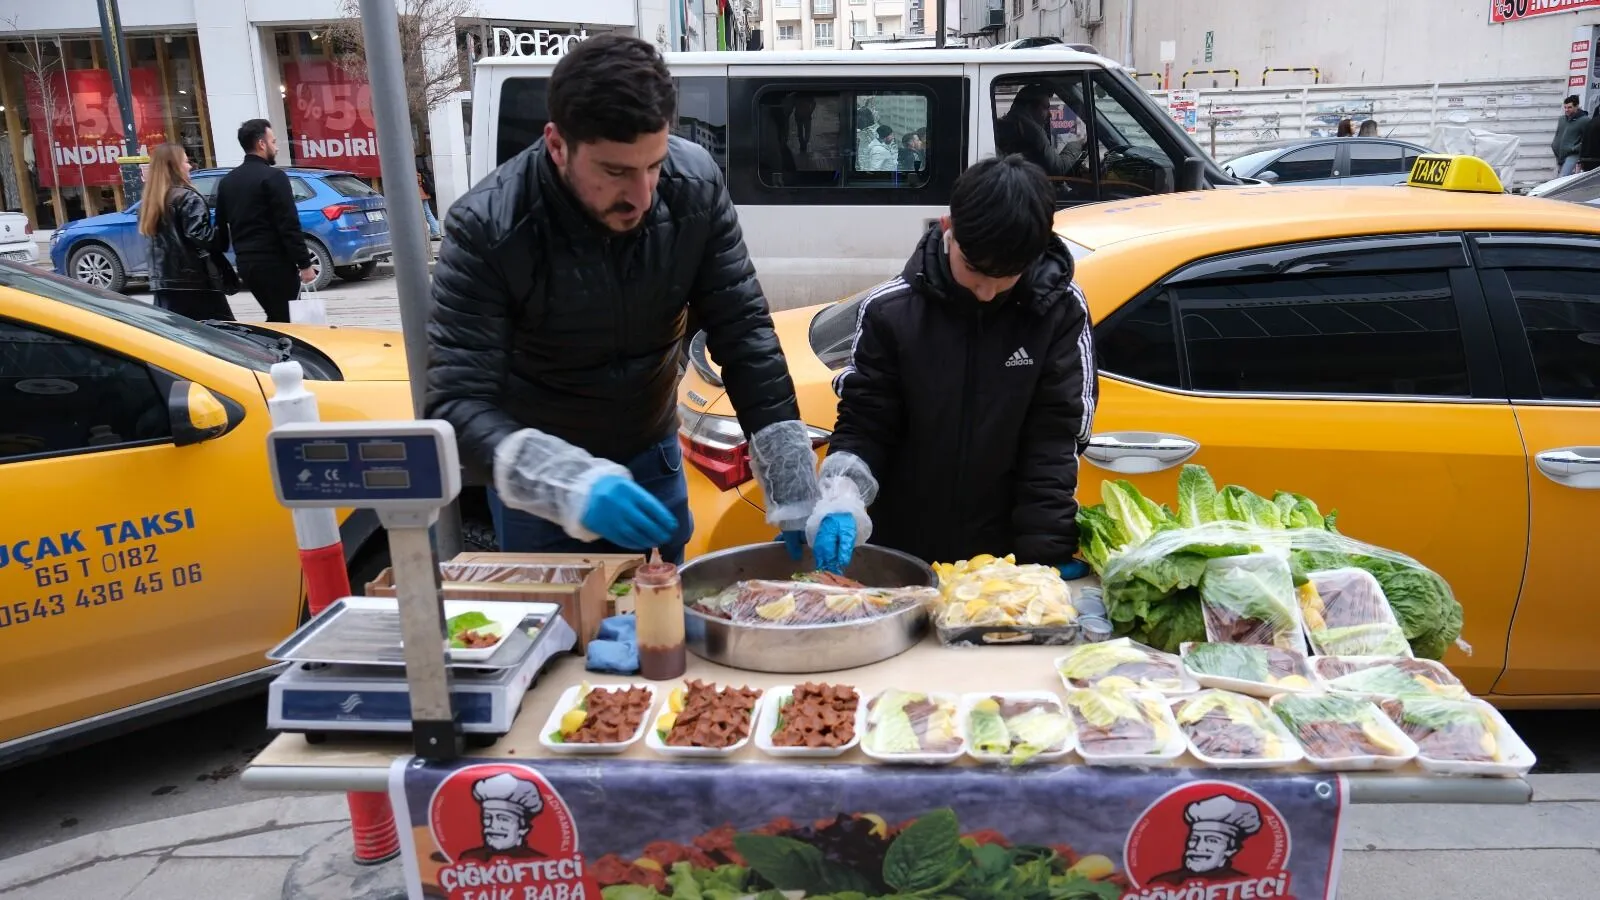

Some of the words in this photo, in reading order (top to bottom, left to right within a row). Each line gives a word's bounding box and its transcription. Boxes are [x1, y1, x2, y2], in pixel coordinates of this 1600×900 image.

[301, 131, 380, 158] İNDİRİ
[1005, 358, 1034, 367] adidas
[96, 508, 195, 546] TAKSI
[35, 563, 69, 588] 65
[77, 558, 91, 577] T
[102, 544, 158, 573] 0182
[0, 594, 65, 628] 0543
[75, 580, 124, 608] 436
[133, 571, 164, 595] 45
[172, 562, 203, 588] 06
[440, 855, 583, 893] ÇİĞKÖFTECİ
[523, 881, 586, 900] BABA
